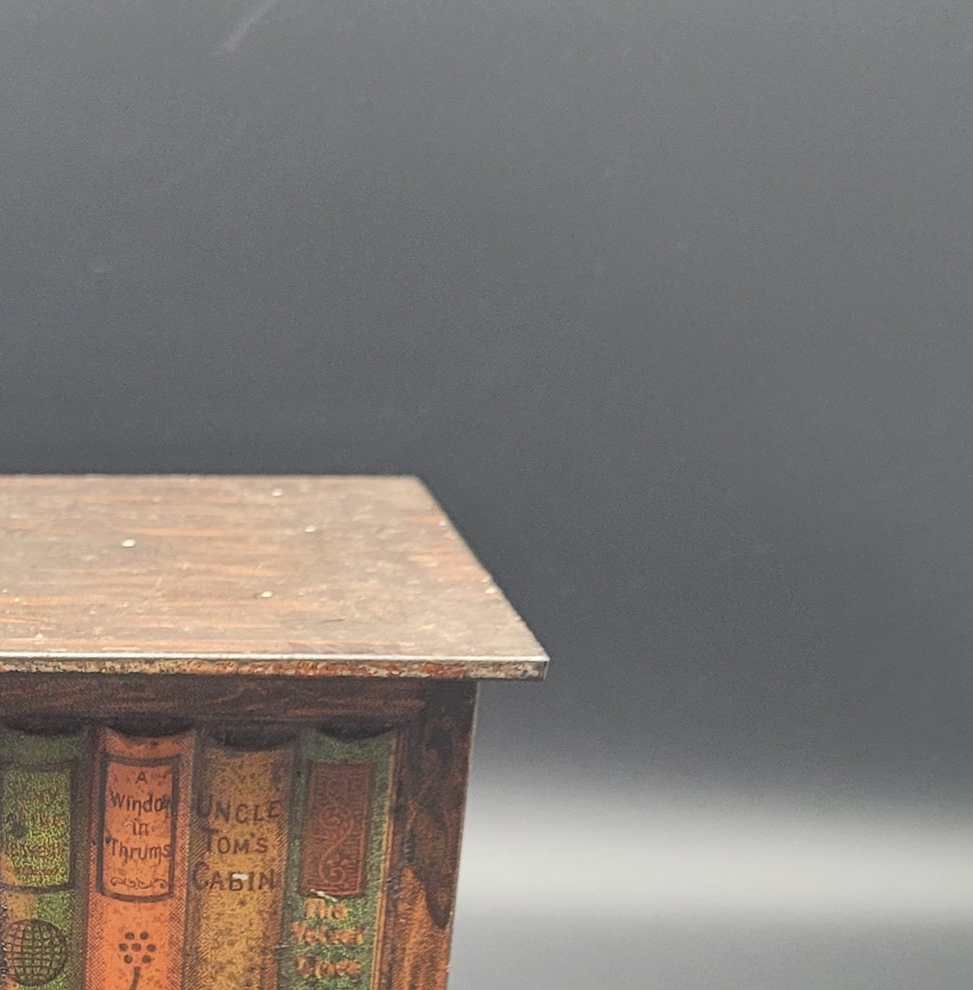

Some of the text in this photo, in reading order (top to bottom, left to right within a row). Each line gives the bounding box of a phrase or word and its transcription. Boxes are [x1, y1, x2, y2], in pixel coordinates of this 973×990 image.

[135, 771, 148, 785] A
[195, 793, 282, 824] UNCLE
[131, 817, 148, 837] in
[109, 838, 172, 865] Thrums
[192, 860, 276, 892] CABIN
